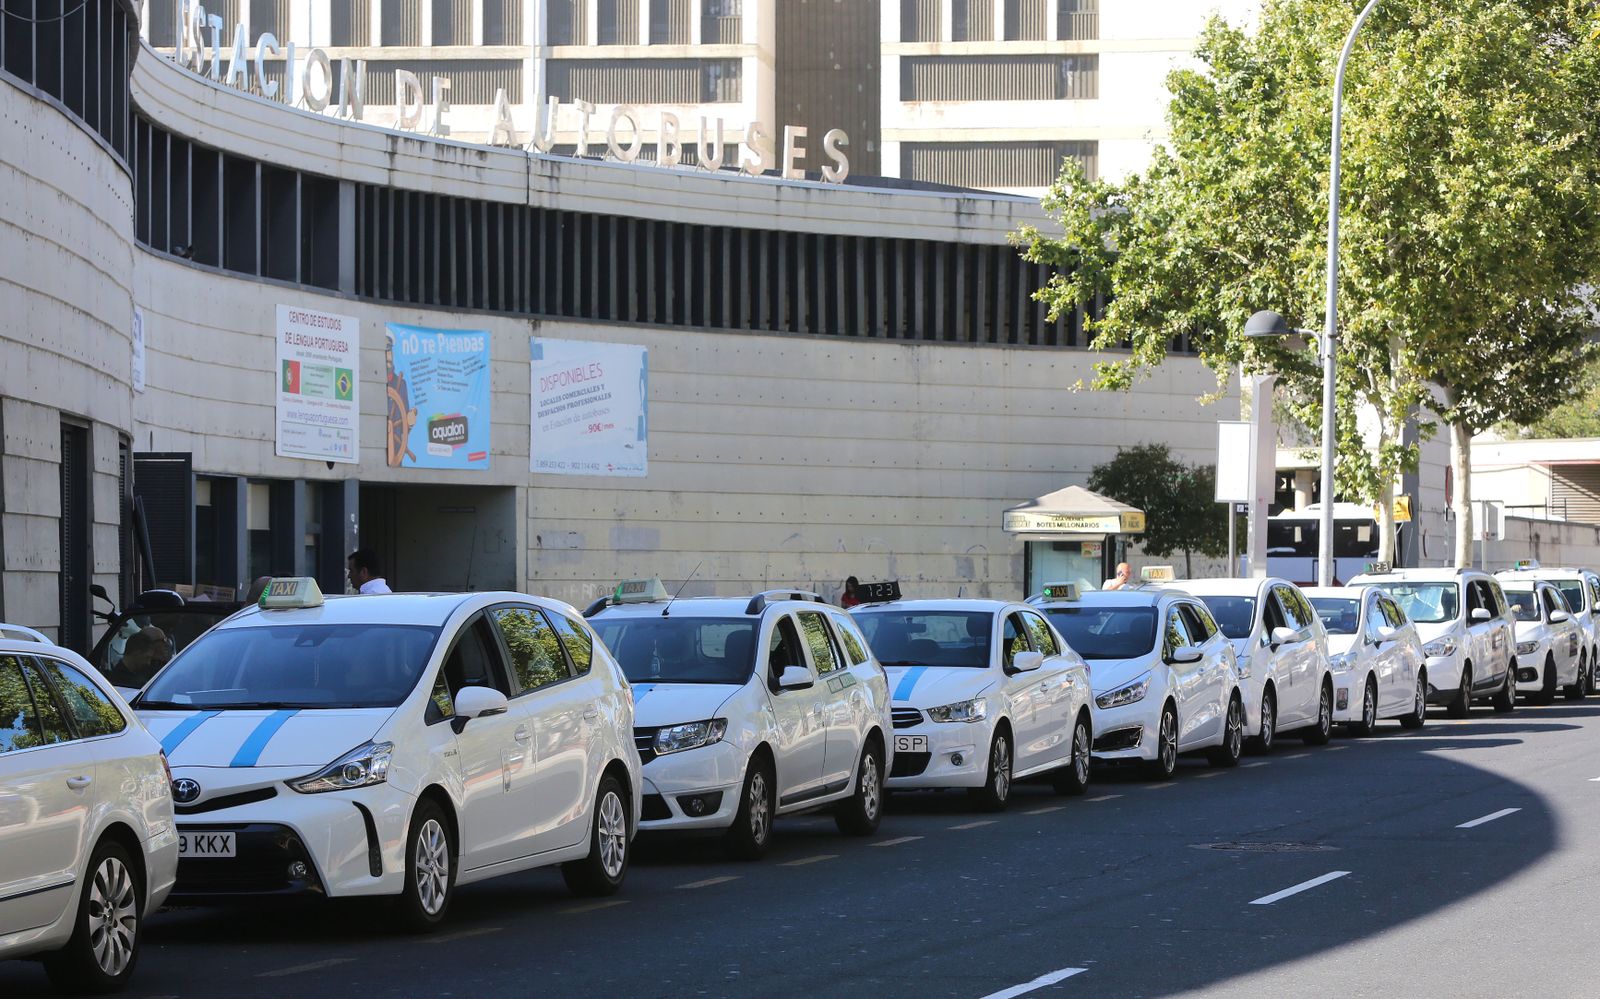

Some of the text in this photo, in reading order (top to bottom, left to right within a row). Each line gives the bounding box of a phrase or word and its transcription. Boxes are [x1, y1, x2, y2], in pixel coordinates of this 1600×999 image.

[395, 69, 451, 136] DE
[486, 87, 850, 184] AUTOBUSES
[288, 310, 342, 331] CENTRO DE ESTUDIOS
[284, 332, 349, 353] DE LENGUA PORTUGUESA
[540, 362, 604, 393] DISPONIBLES
[537, 392, 612, 419] DESPACHOS PROFESIONALES
[540, 395, 562, 408] LOCALES
[562, 385, 600, 401] COMERCIALES
[432, 421, 465, 440] aqualon
[1149, 568, 1166, 579] TAXI
[1370, 562, 1389, 573] 123
[271, 582, 298, 596] TAXI
[623, 582, 646, 594] TAXI
[868, 583, 894, 597] 123
[1051, 586, 1068, 597] TAXI
[195, 835, 231, 853] KKX
